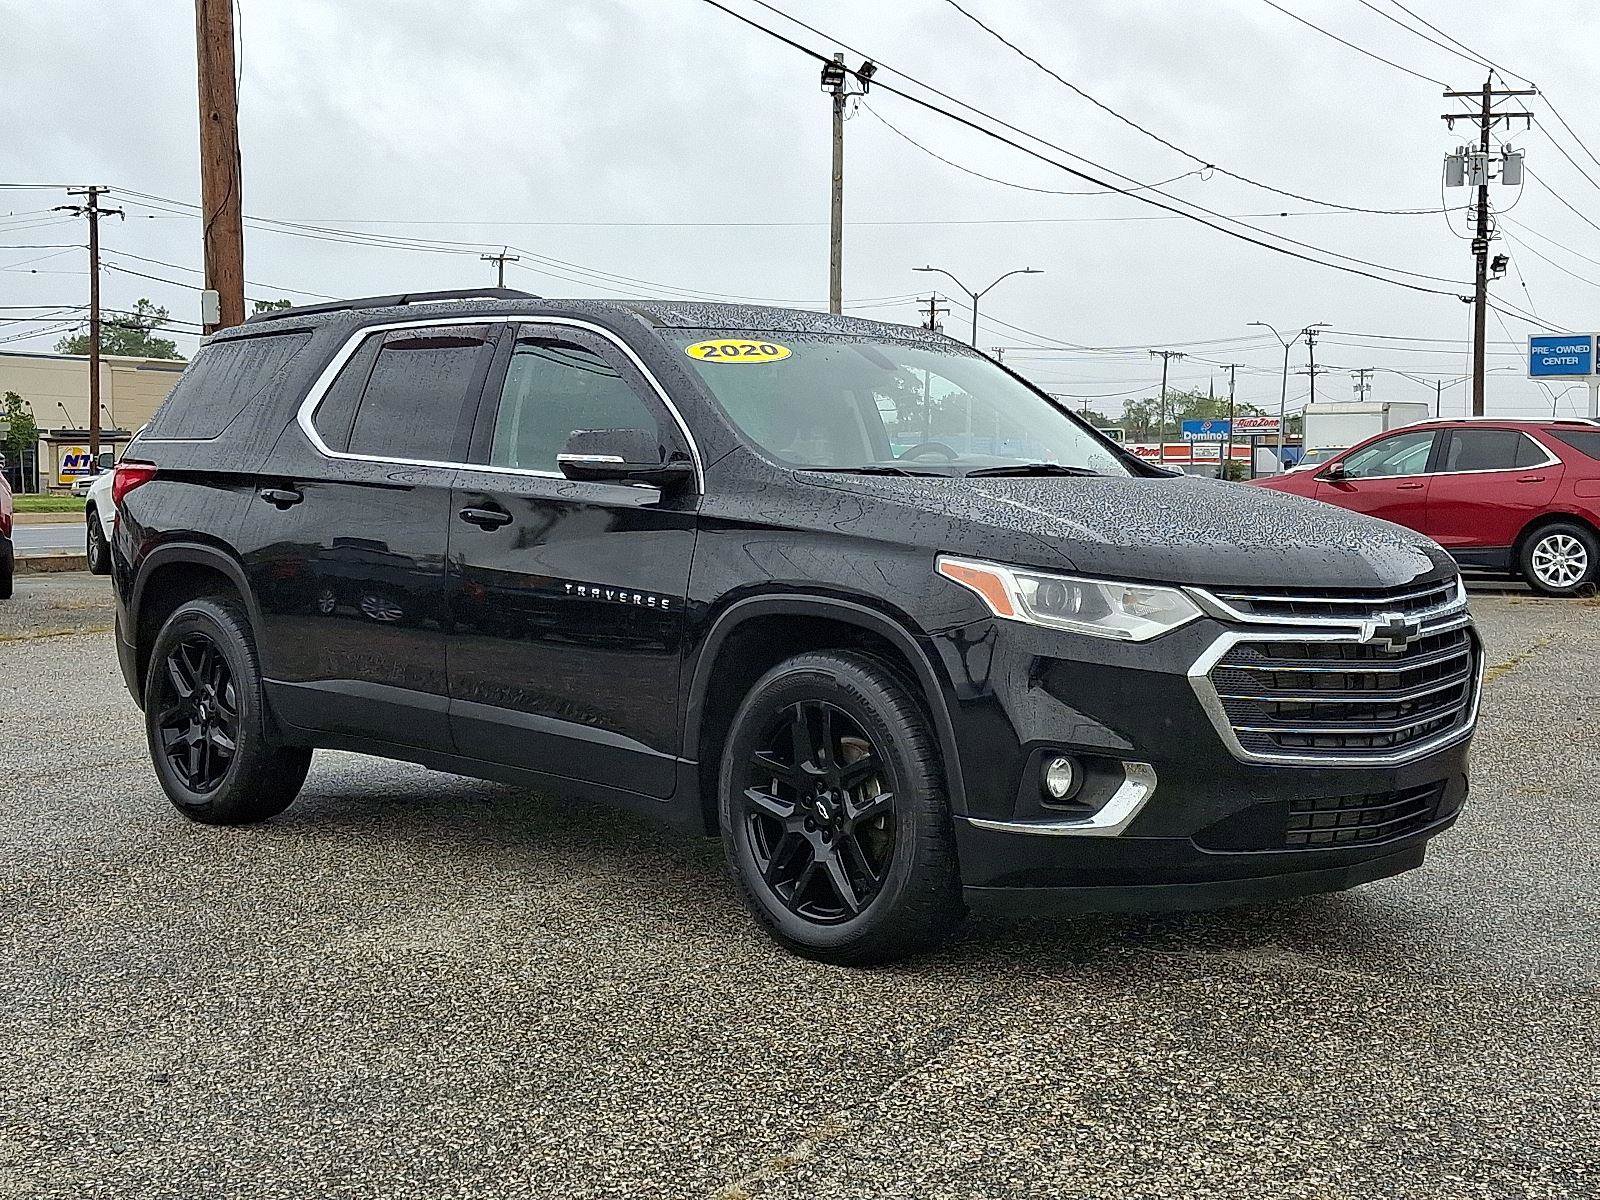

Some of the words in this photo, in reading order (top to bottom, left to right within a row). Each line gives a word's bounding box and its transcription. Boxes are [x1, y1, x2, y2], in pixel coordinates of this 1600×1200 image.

[700, 345, 778, 358] 2020
[1542, 356, 1578, 365] CENTER
[1237, 418, 1280, 428] AutoZone
[1183, 431, 1228, 440] Domino's
[63, 455, 90, 467] NT
[564, 583, 670, 610] TRAVERSE
